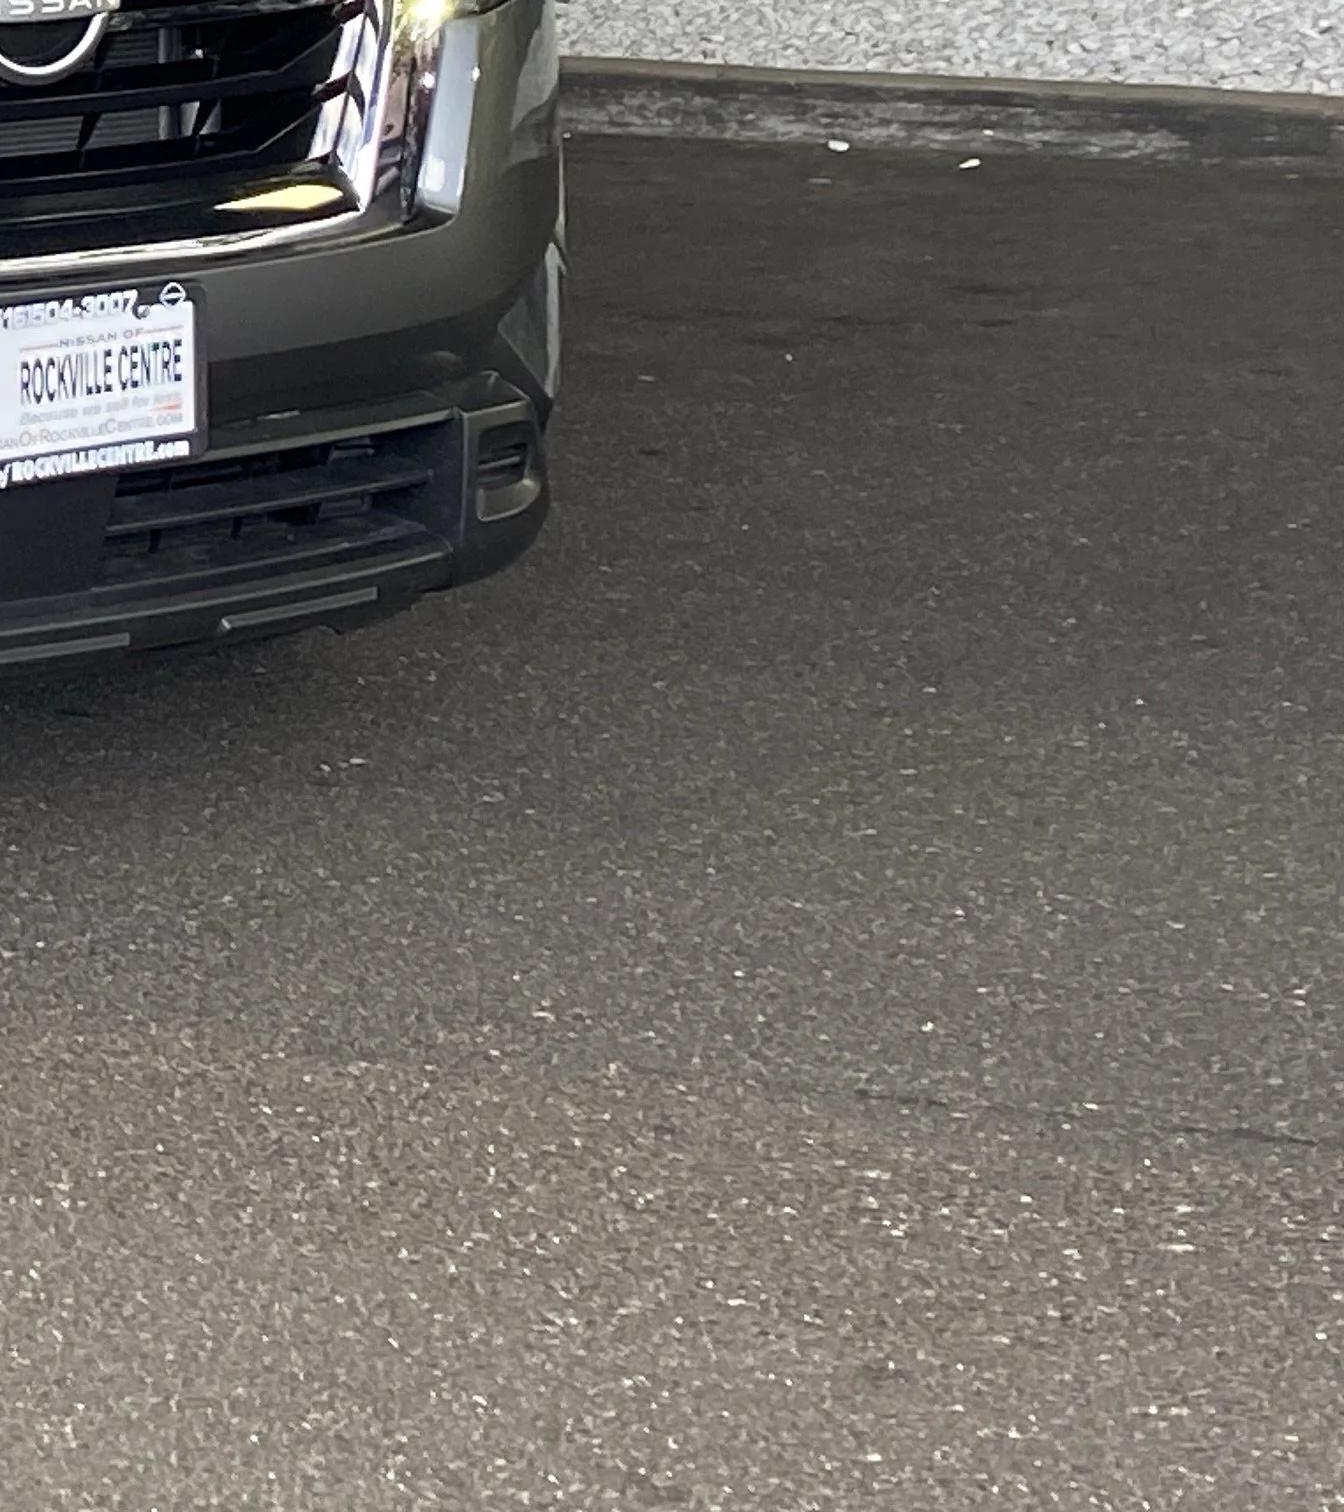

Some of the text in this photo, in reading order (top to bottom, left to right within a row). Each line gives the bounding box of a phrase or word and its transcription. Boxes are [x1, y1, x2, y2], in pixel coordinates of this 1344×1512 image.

[59, 327, 145, 348] NISSAN OF
[19, 338, 183, 406] ROCKVILLE CENTRE
